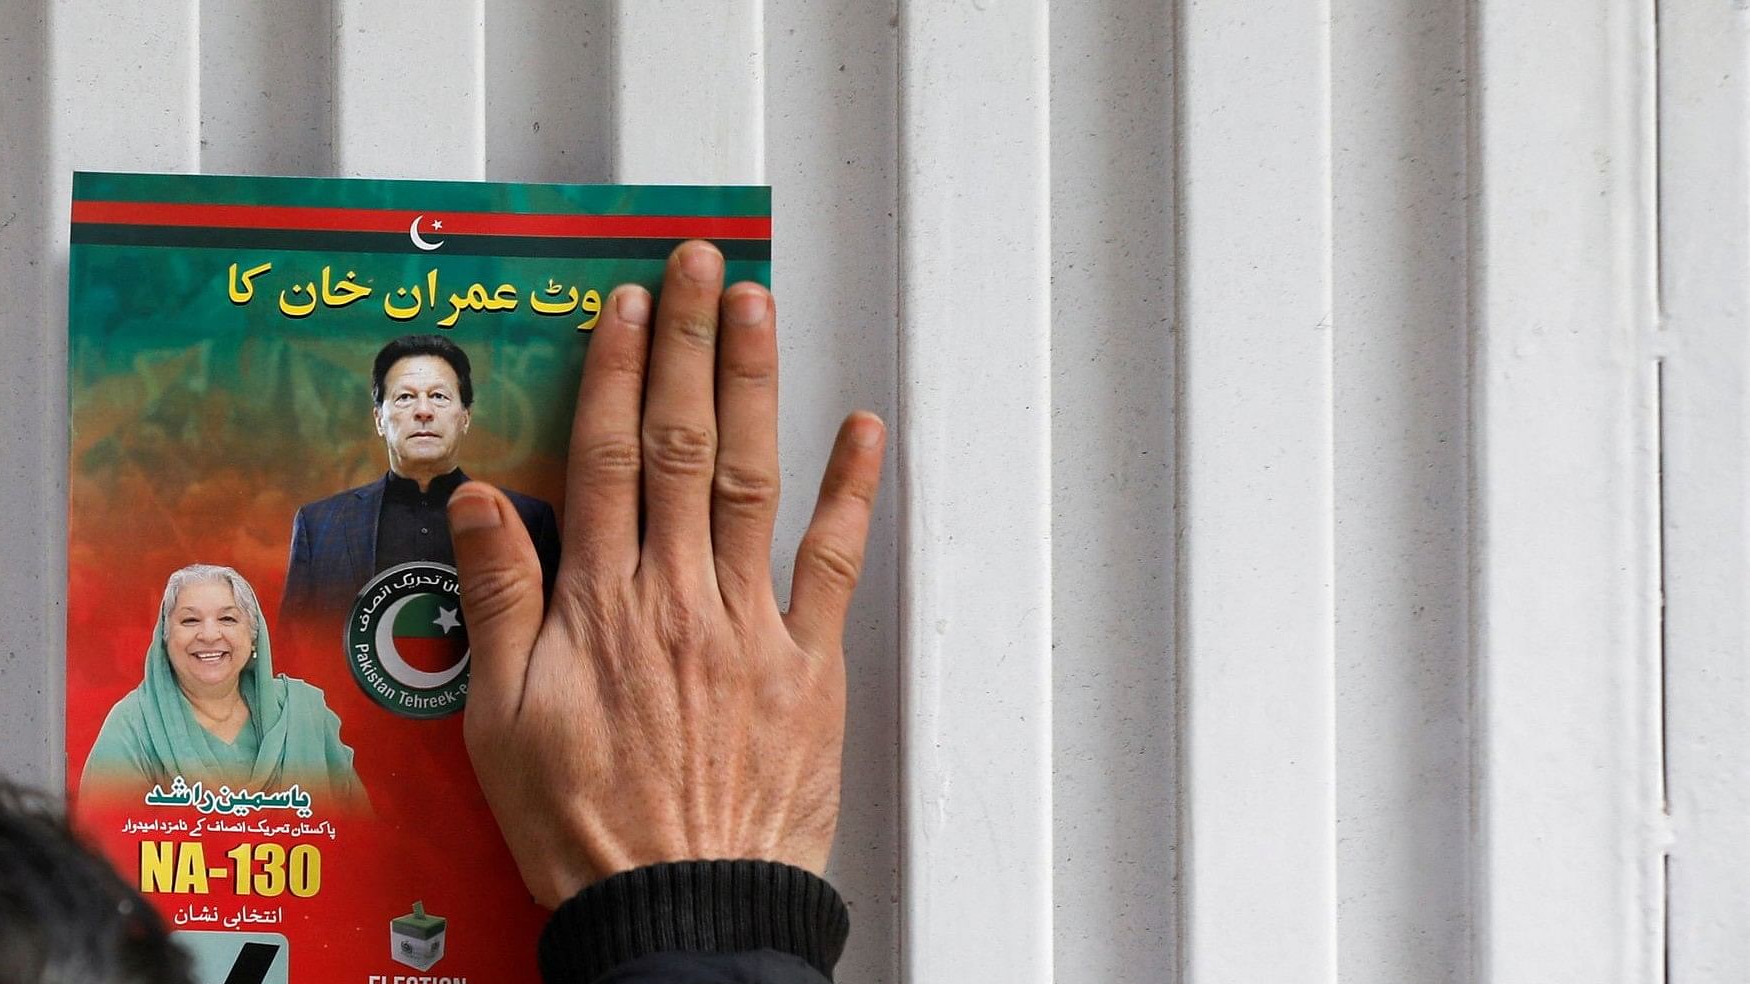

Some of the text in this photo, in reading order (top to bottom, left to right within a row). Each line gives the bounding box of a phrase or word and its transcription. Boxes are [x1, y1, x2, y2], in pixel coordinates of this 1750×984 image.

[228, 262, 602, 330] وٹ عمران خان کا
[393, 573, 443, 589] تحریک
[359, 584, 393, 632] انصاف
[354, 643, 470, 709] Pakistan Tehreek-e
[145, 776, 313, 818] یاسمین راشد
[121, 817, 336, 840] پاکستان تحریک انصاف کے نامزد امیدوار
[139, 840, 322, 898] NA-130
[173, 903, 283, 931] انتخابی نشان
